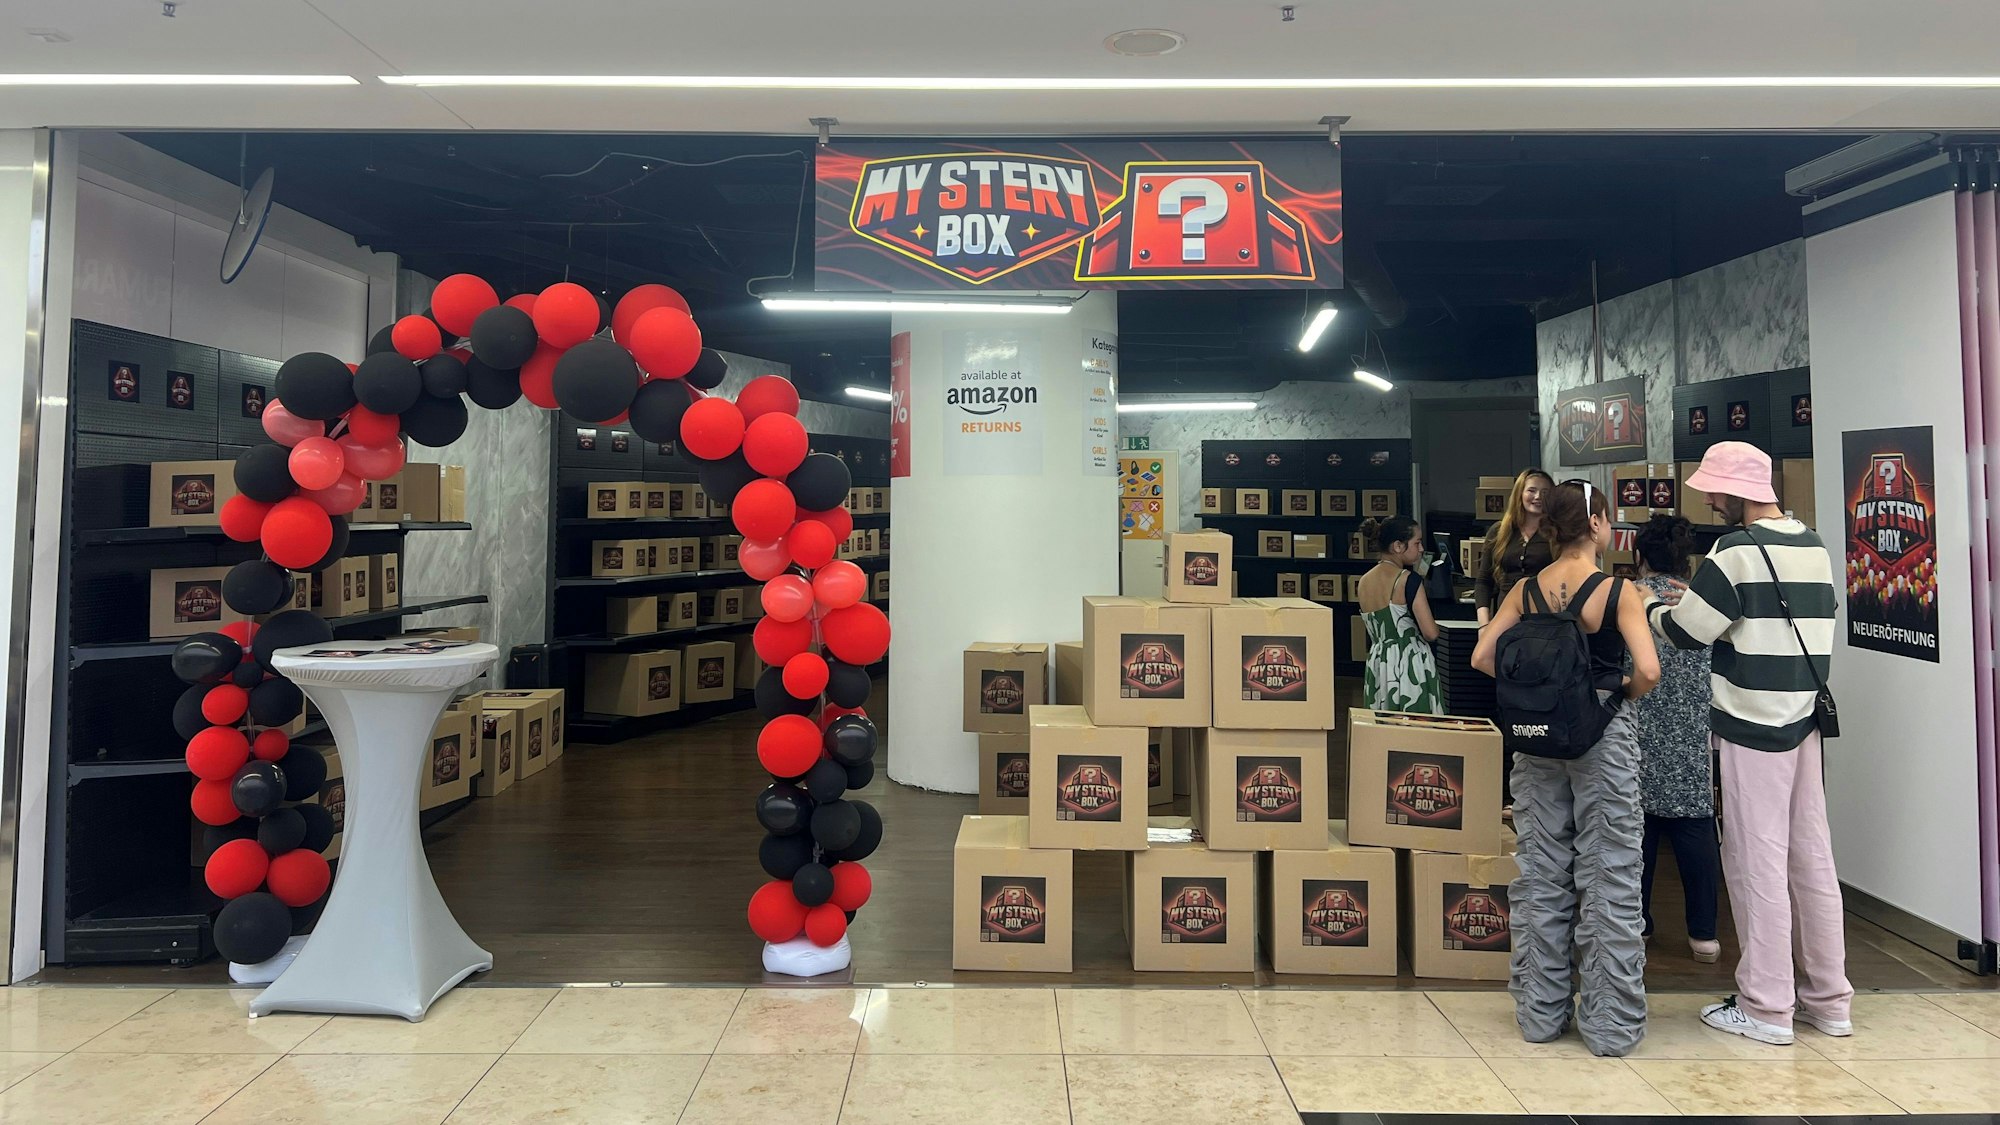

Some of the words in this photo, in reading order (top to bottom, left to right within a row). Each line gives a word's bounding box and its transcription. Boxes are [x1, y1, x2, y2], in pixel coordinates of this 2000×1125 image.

[936, 214, 1015, 258] BOX
[961, 370, 1007, 381] available
[1011, 371, 1022, 380] at
[947, 386, 1037, 405] amazon
[961, 422, 1022, 433] RETURNS
[1854, 500, 1925, 535] MYSTERY
[1878, 528, 1902, 554] BOX
[1853, 621, 1936, 649] NEUERÖFFNUNG
[1145, 675, 1162, 685] BOX
[1267, 677, 1284, 687] BOX
[1512, 724, 1545, 738] snipes
[1081, 797, 1098, 807] BOX
[1261, 798, 1279, 808] BOX
[1415, 800, 1436, 812] BOX
[1005, 918, 1023, 929] BOX
[1186, 918, 1204, 929] BOX
[1327, 921, 1345, 932] BOX
[1469, 926, 1487, 937] BOX
